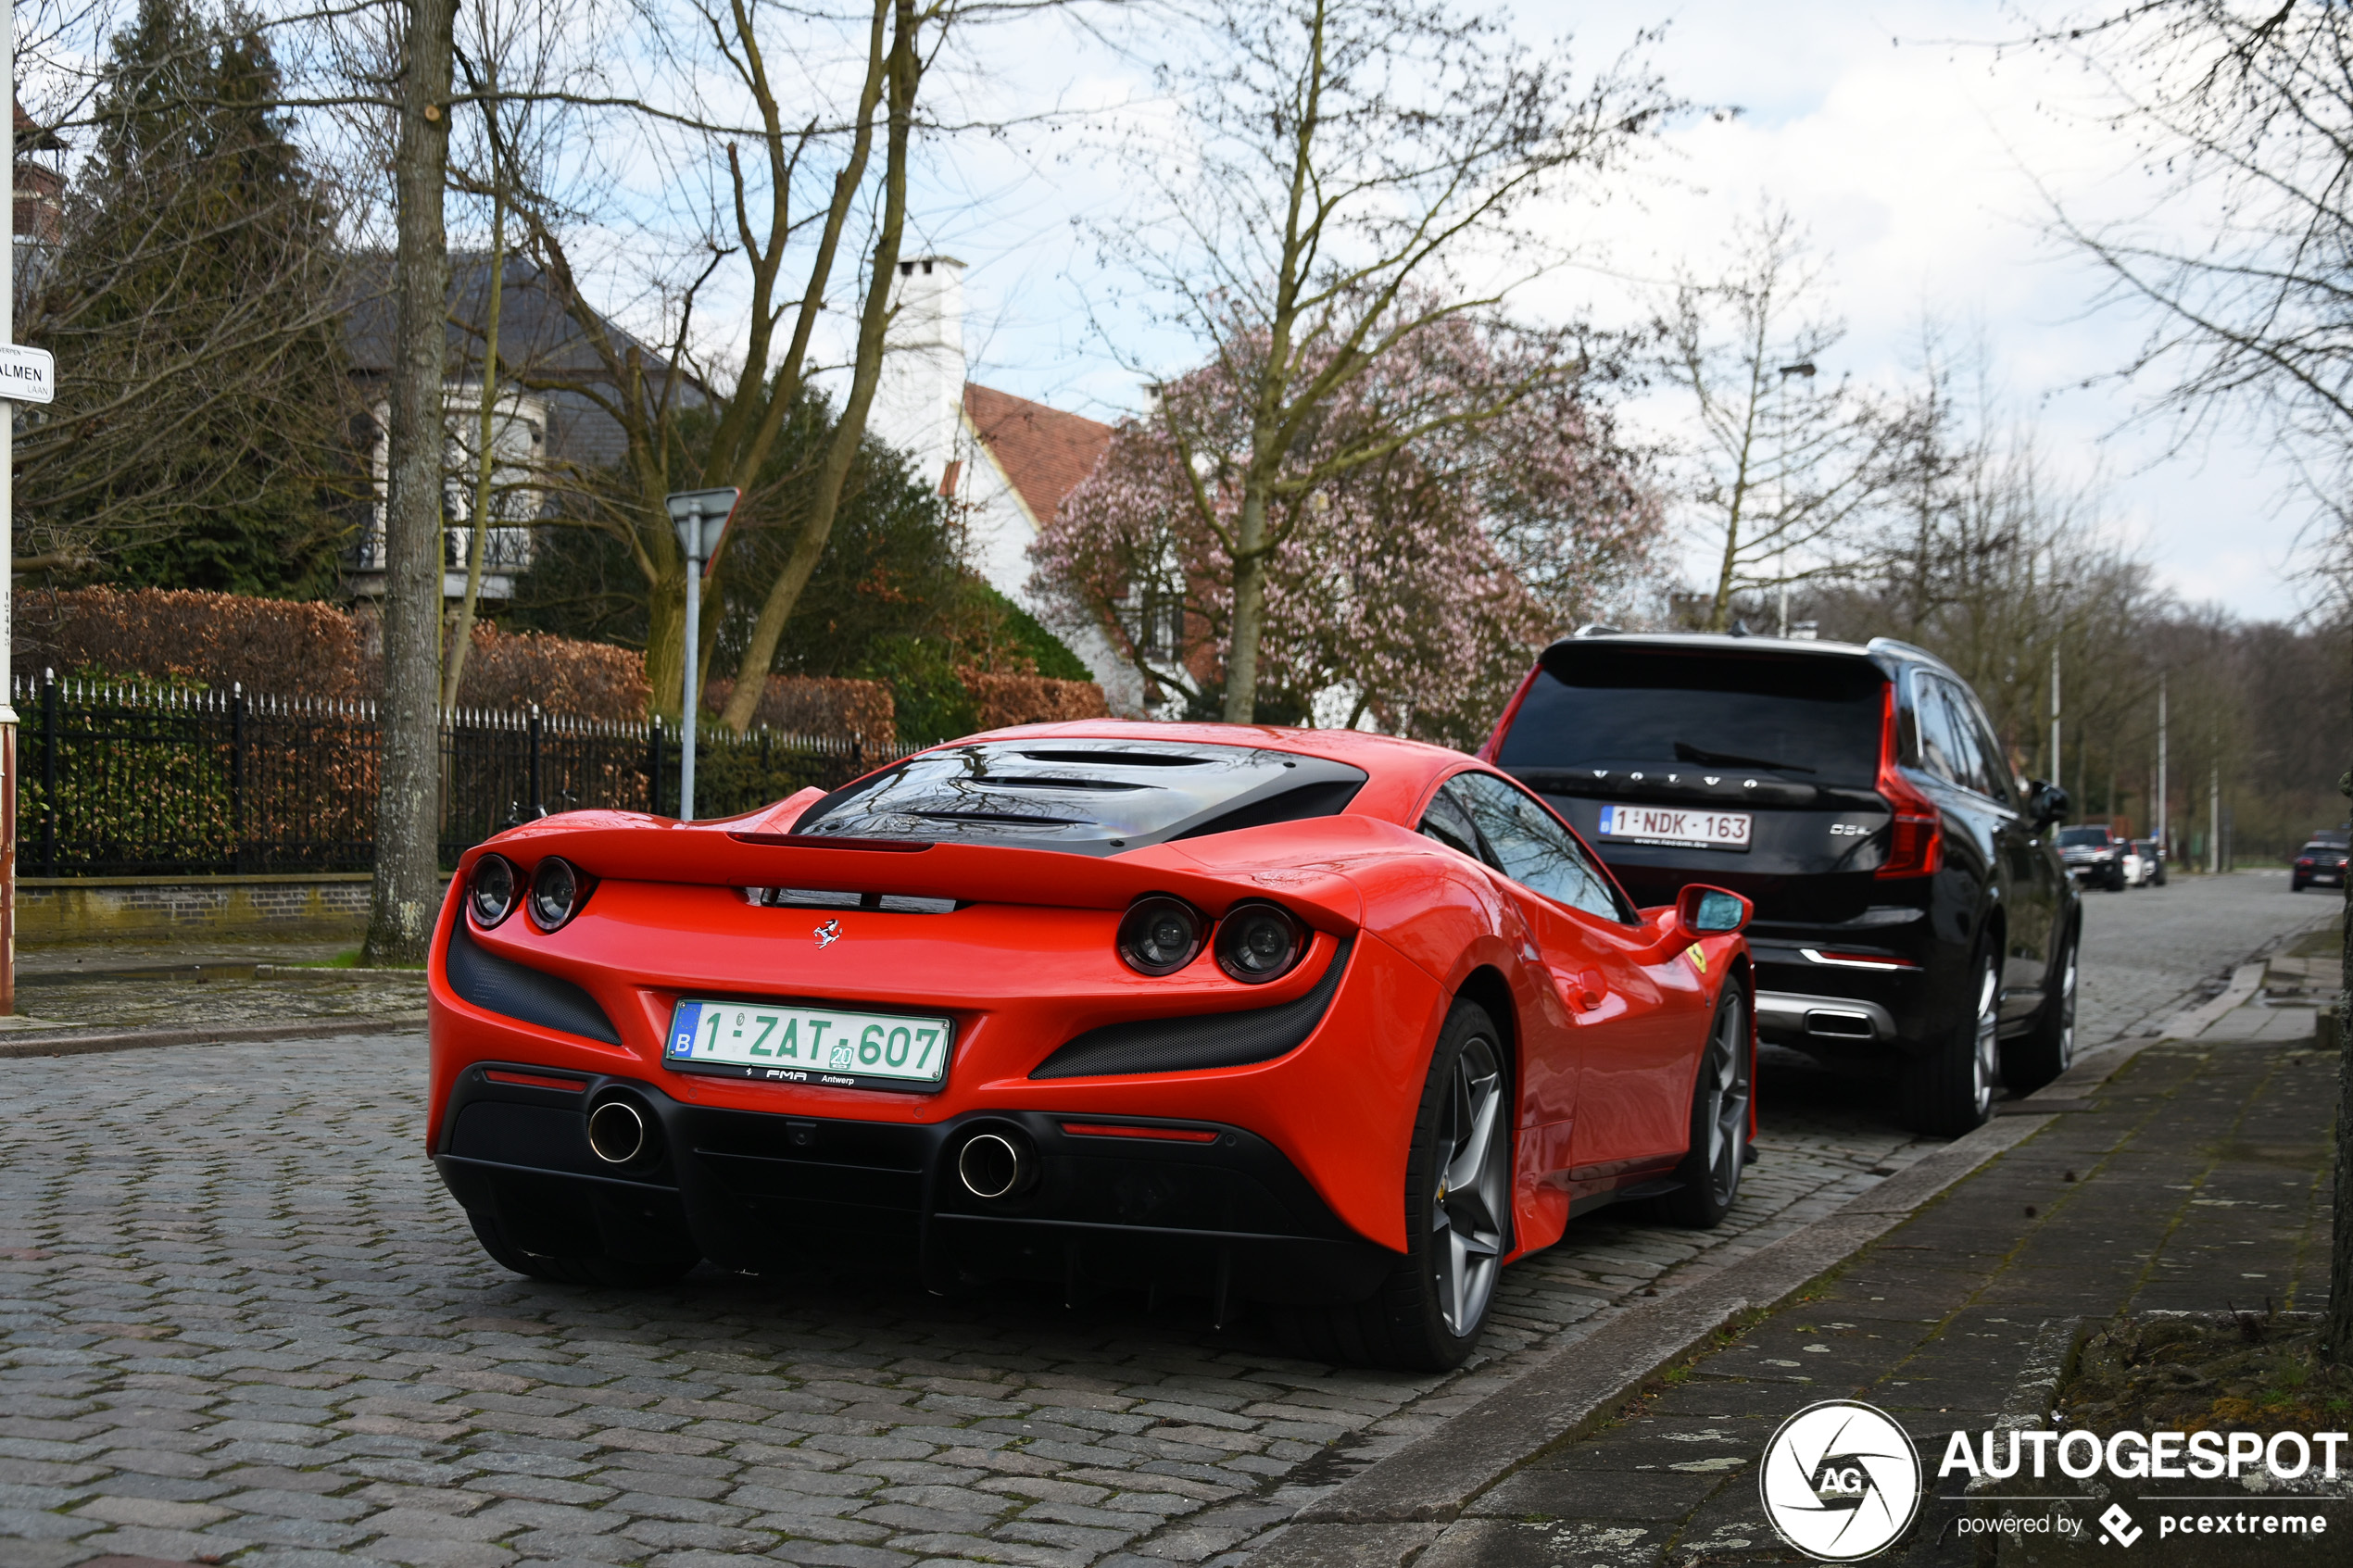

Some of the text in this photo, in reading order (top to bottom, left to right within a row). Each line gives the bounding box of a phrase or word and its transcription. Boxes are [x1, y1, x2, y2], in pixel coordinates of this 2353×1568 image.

[0, 347, 21, 356] ERPEN
[27, 384, 48, 395] LAAN
[1592, 769, 1758, 789] VOLVO
[675, 1033, 691, 1052] B
[830, 1047, 853, 1065] 20
[766, 1069, 855, 1086] FMA Antwerp
